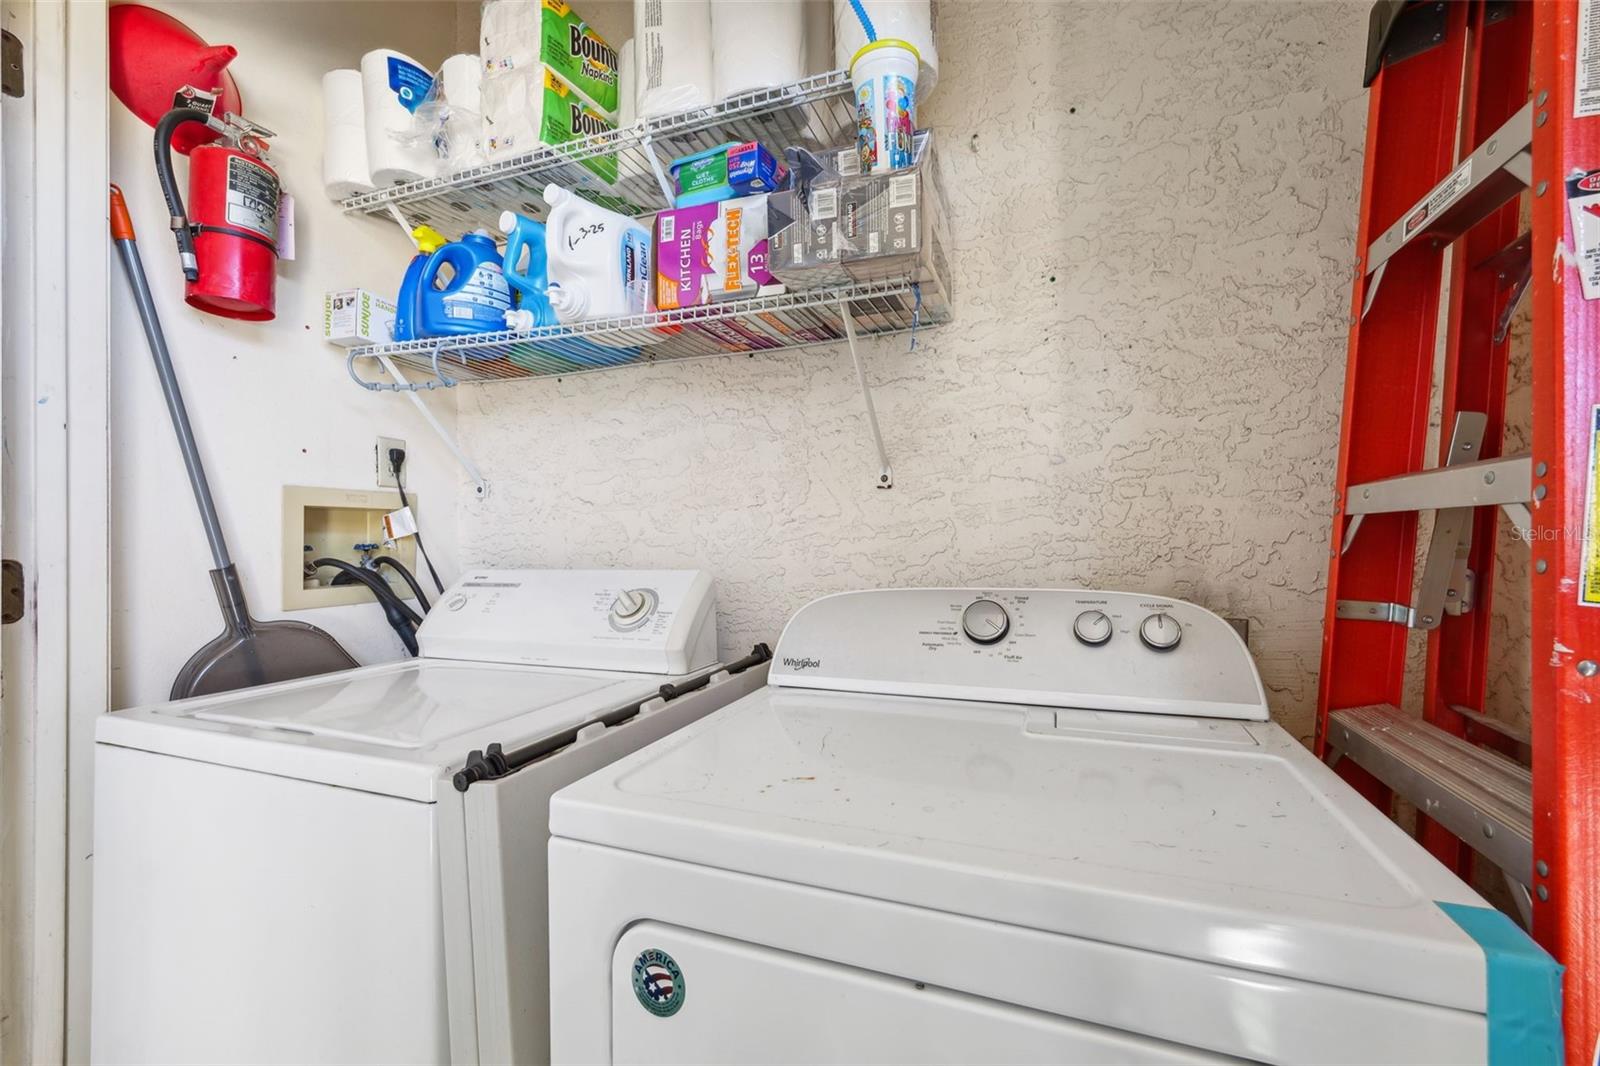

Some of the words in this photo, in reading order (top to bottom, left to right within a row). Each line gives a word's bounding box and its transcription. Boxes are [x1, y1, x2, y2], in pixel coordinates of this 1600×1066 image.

[581, 61, 613, 85] Napkins
[691, 176, 714, 186] CLOTHS
[694, 220, 703, 240] Bags
[680, 228, 691, 291] KITCHEN
[750, 254, 764, 274] 13
[361, 292, 371, 337] SUNJOE
[783, 657, 820, 671] Whirlpool
[634, 951, 680, 980] AMERICA
